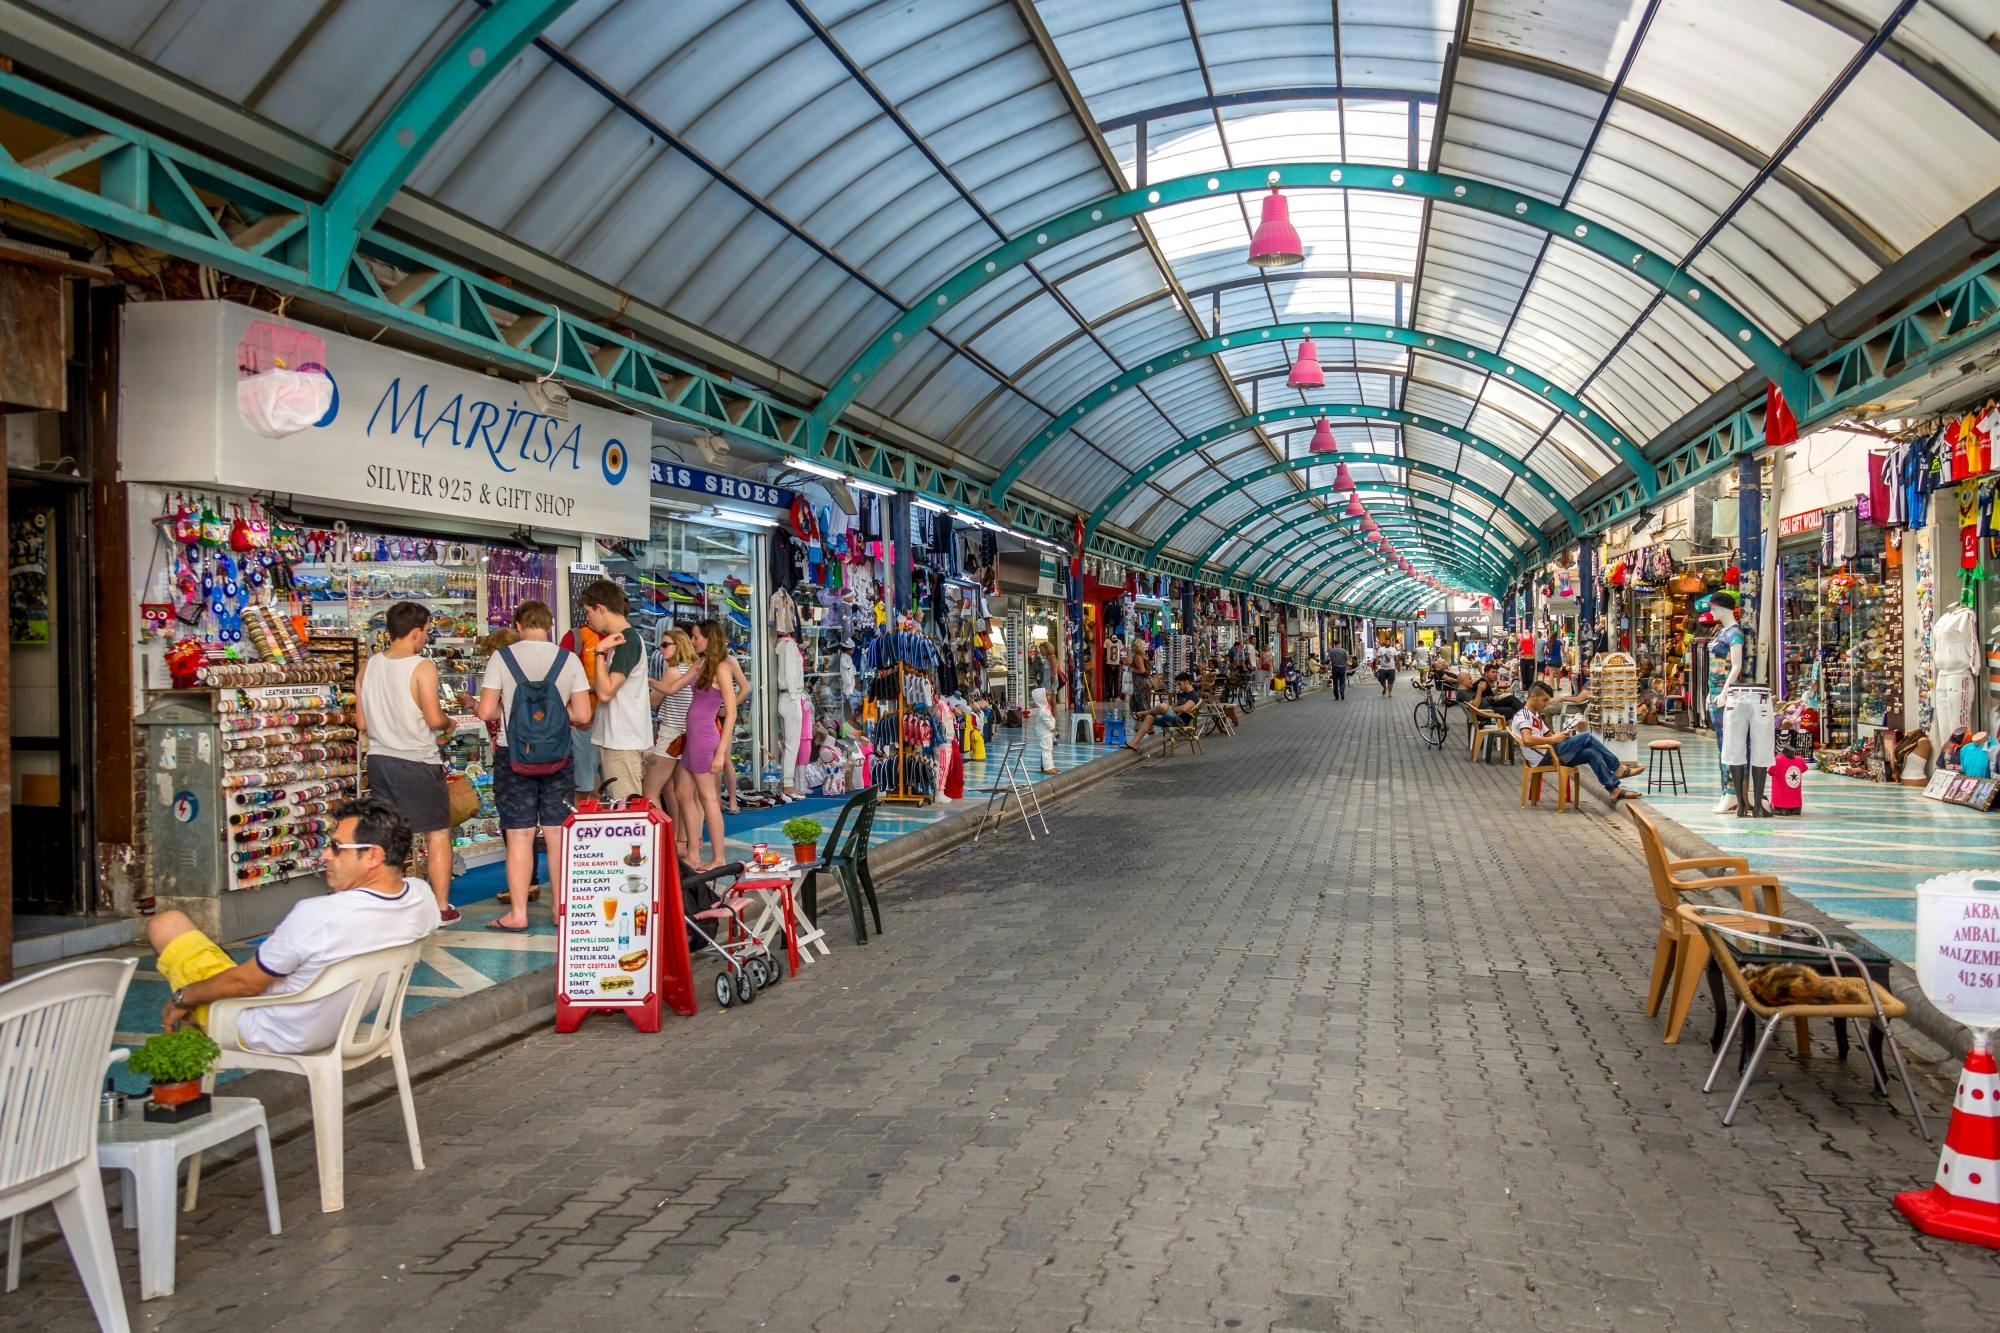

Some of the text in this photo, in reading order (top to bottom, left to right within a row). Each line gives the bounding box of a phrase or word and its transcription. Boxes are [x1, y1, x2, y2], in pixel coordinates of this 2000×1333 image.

[366, 377, 582, 473] MARİTSA
[366, 464, 575, 517] SILVER 925 & GIFT SHOP
[705, 475, 779, 505] SHOES
[1803, 510, 1822, 528] WORLD
[265, 687, 318, 696] LEATHER BRACELET
[605, 822, 646, 838] OCAĞI
[573, 844, 591, 852] ÇAY
[593, 877, 610, 885] ÇAYI
[593, 886, 611, 894] ÇAYI
[1957, 969, 1976, 987] 412
[1979, 972, 1994, 989] 56
